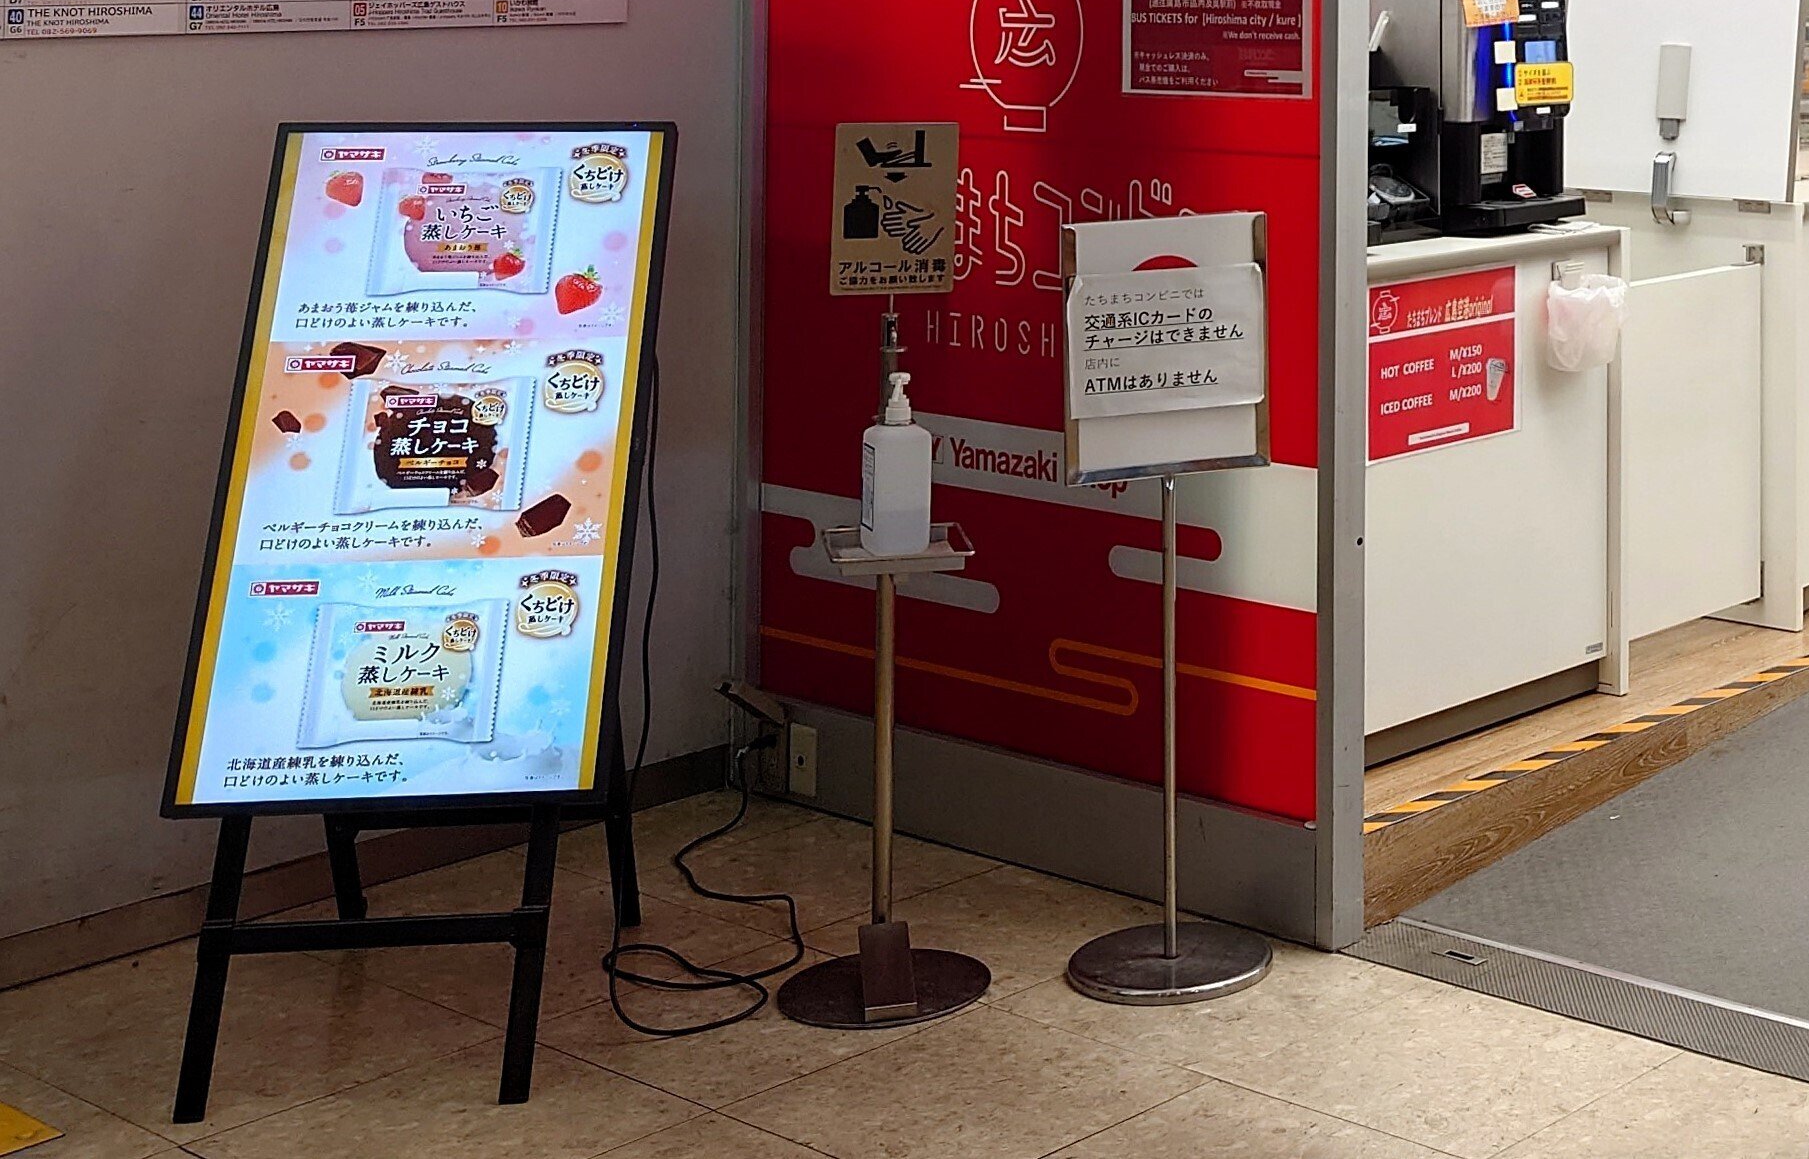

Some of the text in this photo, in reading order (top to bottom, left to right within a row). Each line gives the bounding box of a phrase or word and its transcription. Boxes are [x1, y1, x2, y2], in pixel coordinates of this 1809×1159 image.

[28, 6, 153, 18] THE KNOT HIROSHIMA
[1131, 13, 1146, 24] BUS
[1149, 13, 1183, 24] TICKETS
[1185, 13, 1198, 24] for
[1250, 14, 1267, 27] city
[1276, 14, 1296, 26] kure
[1239, 31, 1257, 40] don't
[1258, 32, 1283, 40] receive
[338, 149, 383, 161] ヤマザキ
[573, 163, 625, 183] くちどけ
[580, 183, 615, 192] 蒸しケーキ
[436, 205, 500, 224] いちご
[421, 224, 508, 242] 蒸しケーキ
[839, 258, 946, 274] アルコール消毒
[1085, 288, 1204, 306] たちまちコンビニでは
[297, 300, 479, 316] あまおう苺ジャムを練り込んだ、
[294, 315, 472, 331] 口どけのよい蒸しケーキです。
[1085, 308, 1213, 331] 交通系ICカードの
[1085, 324, 1244, 350] チャージはできません
[304, 357, 354, 371] ヤマザキ
[1085, 357, 1120, 371] 店内に
[1380, 365, 1400, 380] HOT
[1402, 358, 1435, 375] COFFEE
[547, 372, 600, 392] くちどけ
[1085, 370, 1218, 393] ATMはありません
[400, 397, 434, 406] ヤマザキ
[555, 391, 590, 401] 蒸しケーキ
[1380, 400, 1401, 416] ICED
[1401, 394, 1434, 411] COFFEE
[408, 417, 469, 437] チョコ
[390, 437, 480, 456] 蒸しケーキ
[950, 436, 1058, 483] Yamazaki
[262, 517, 485, 535] ベルギーチョコクリームを練り込んだ、
[259, 535, 434, 551] 口どけのよい蒸しケーキです。
[268, 582, 317, 595] ヤマザキ
[520, 593, 575, 615] くちどけ
[367, 622, 403, 631] ヤマザキ
[528, 614, 565, 624] 蒸しケーキ
[374, 642, 441, 664] ミルク
[357, 665, 450, 685] 蒸しケーキ
[374, 687, 429, 697] 北海道産練乳
[227, 753, 407, 772] 北海道産練乳を練り込んだ、
[223, 771, 411, 789] 口どけのよい蒸しケーキです。
